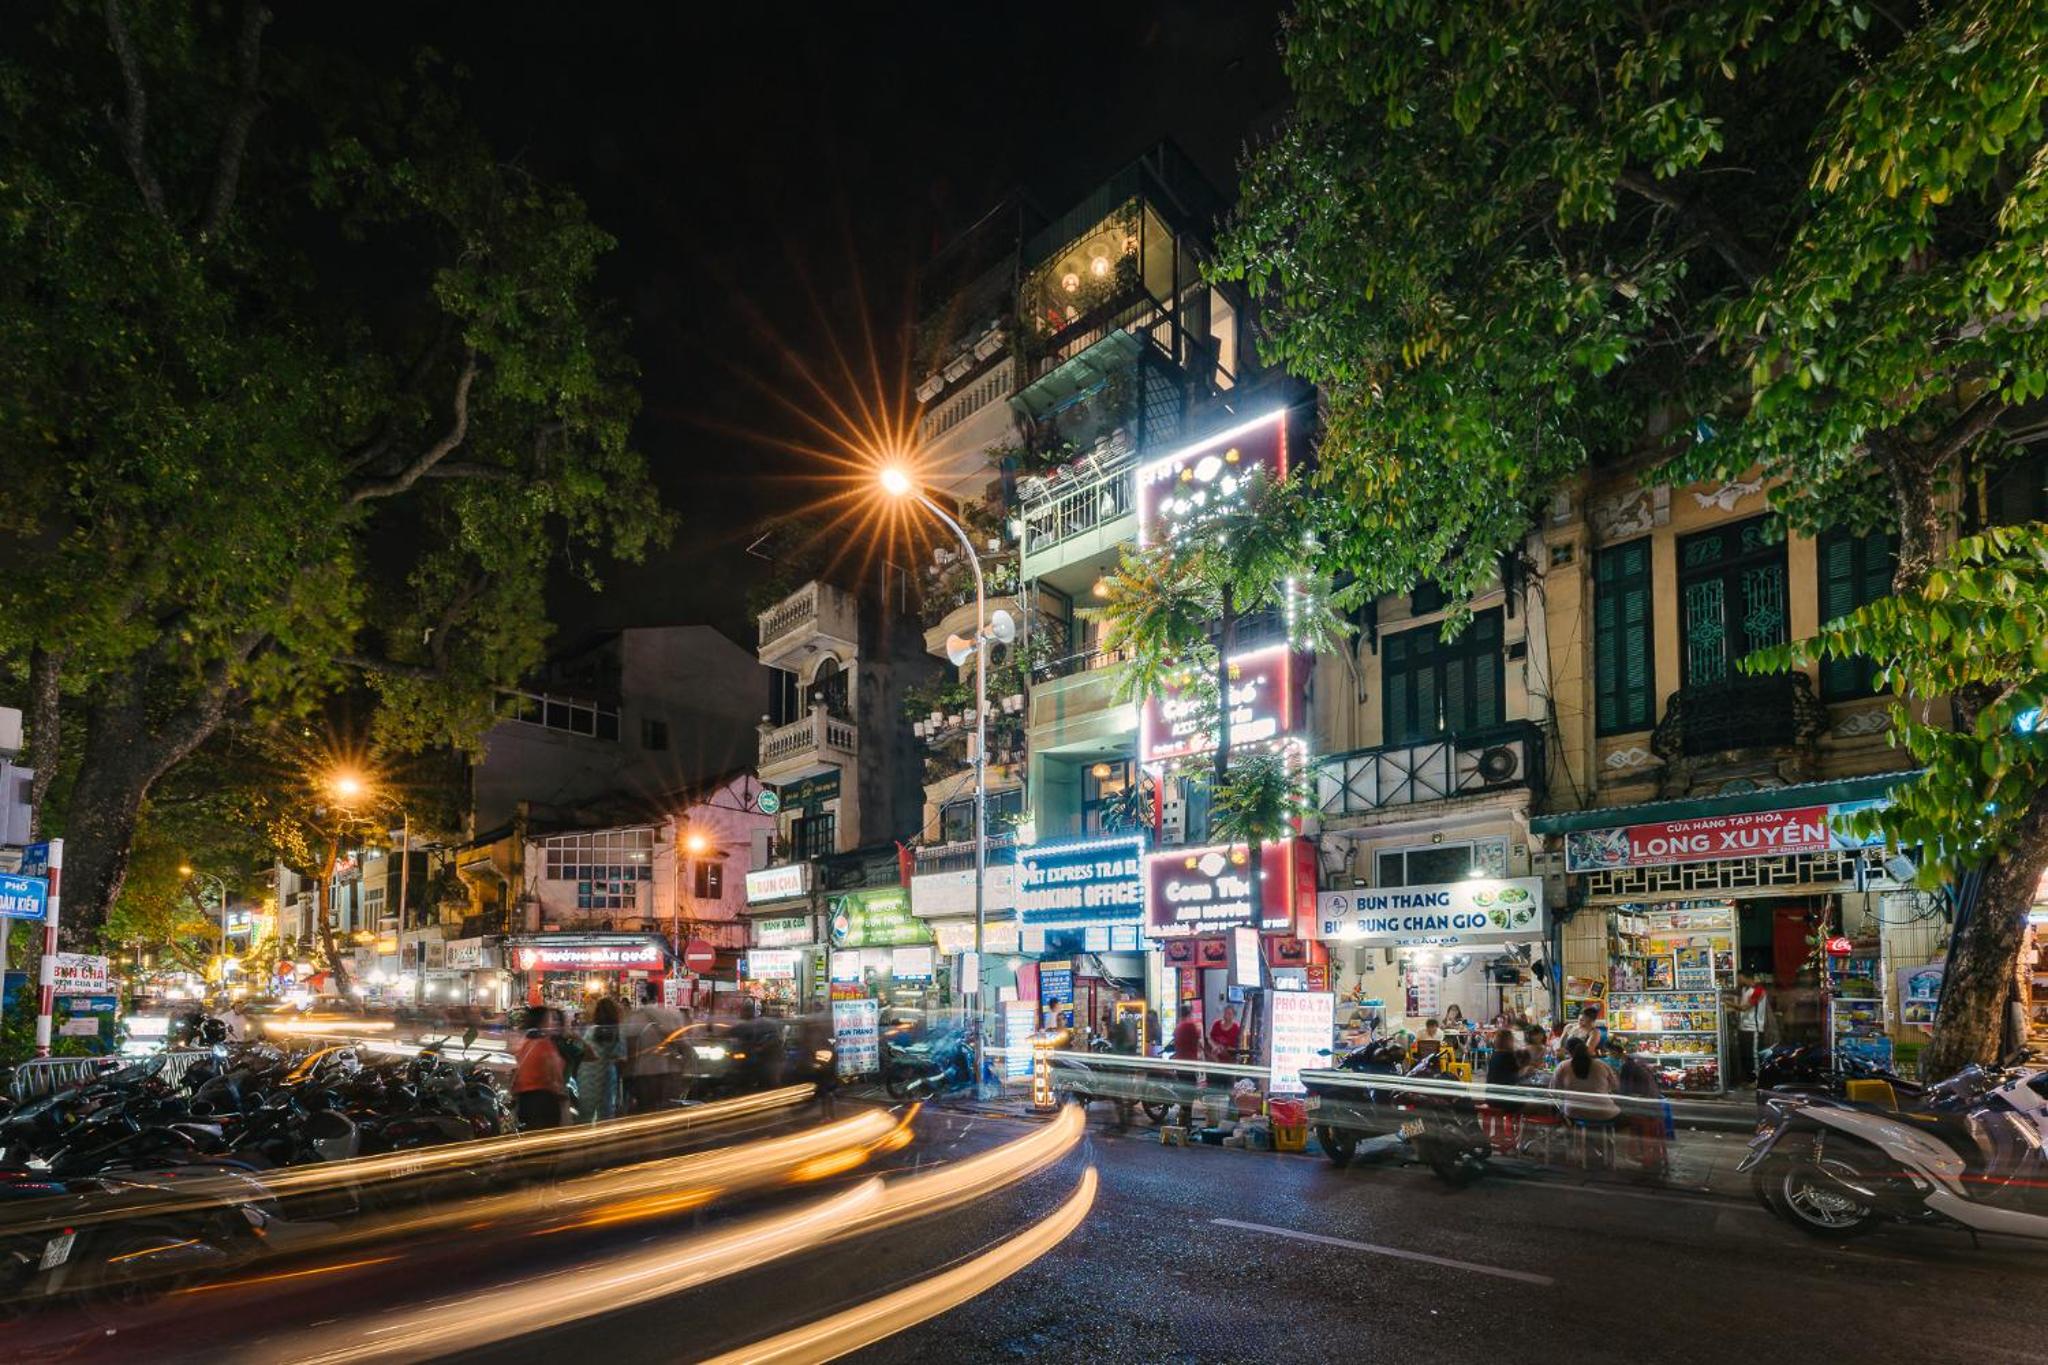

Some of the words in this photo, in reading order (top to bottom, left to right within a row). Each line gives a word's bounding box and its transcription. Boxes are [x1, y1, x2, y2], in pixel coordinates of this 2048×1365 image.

[1634, 835, 1710, 858] LONG
[1047, 864, 1094, 883] EXPRESS
[1084, 881, 1140, 907] OFFICE
[1391, 892, 1449, 909] THANG
